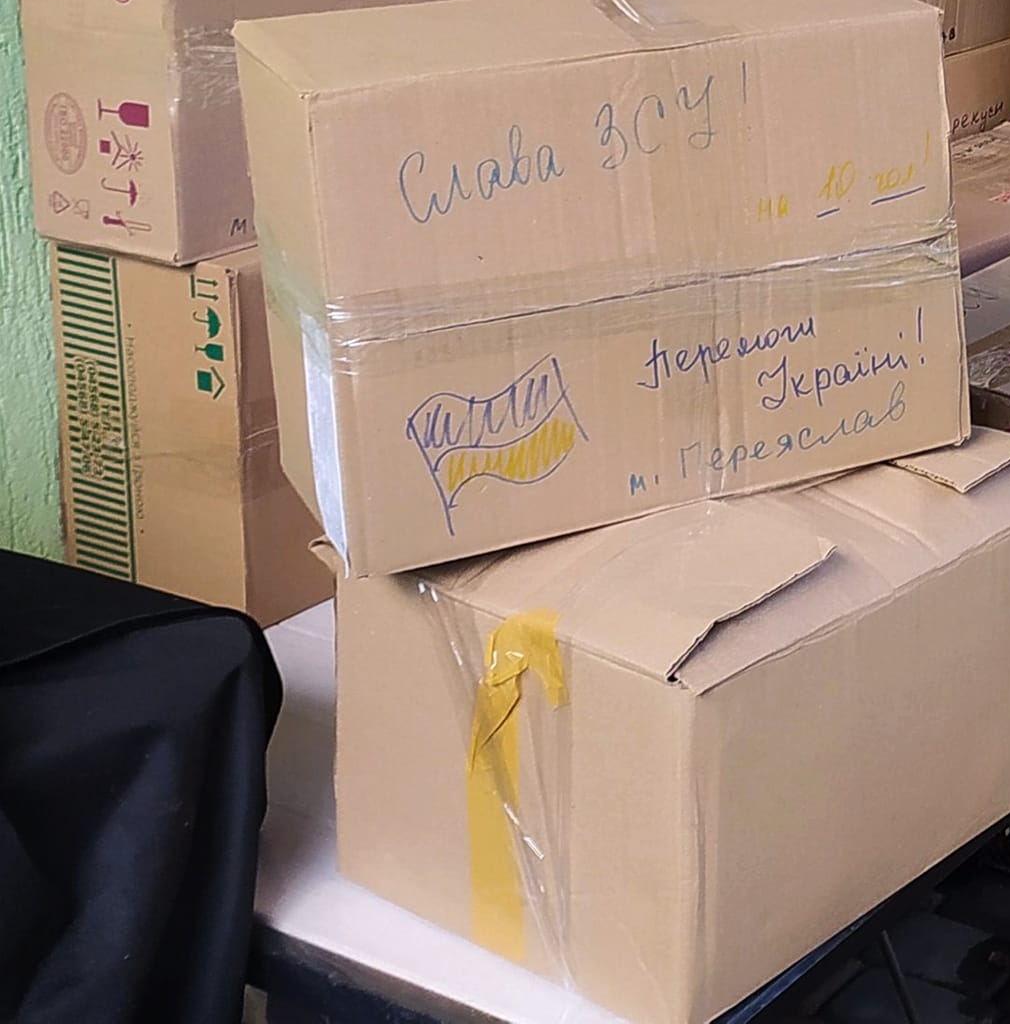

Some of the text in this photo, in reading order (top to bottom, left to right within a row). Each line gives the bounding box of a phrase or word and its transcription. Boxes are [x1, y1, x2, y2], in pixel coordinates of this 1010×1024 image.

[951, 100, 1005, 134] рекуси
[399, 124, 565, 225] Слава
[637, 316, 817, 389] Перемоги
[679, 380, 907, 481] Переяслав
